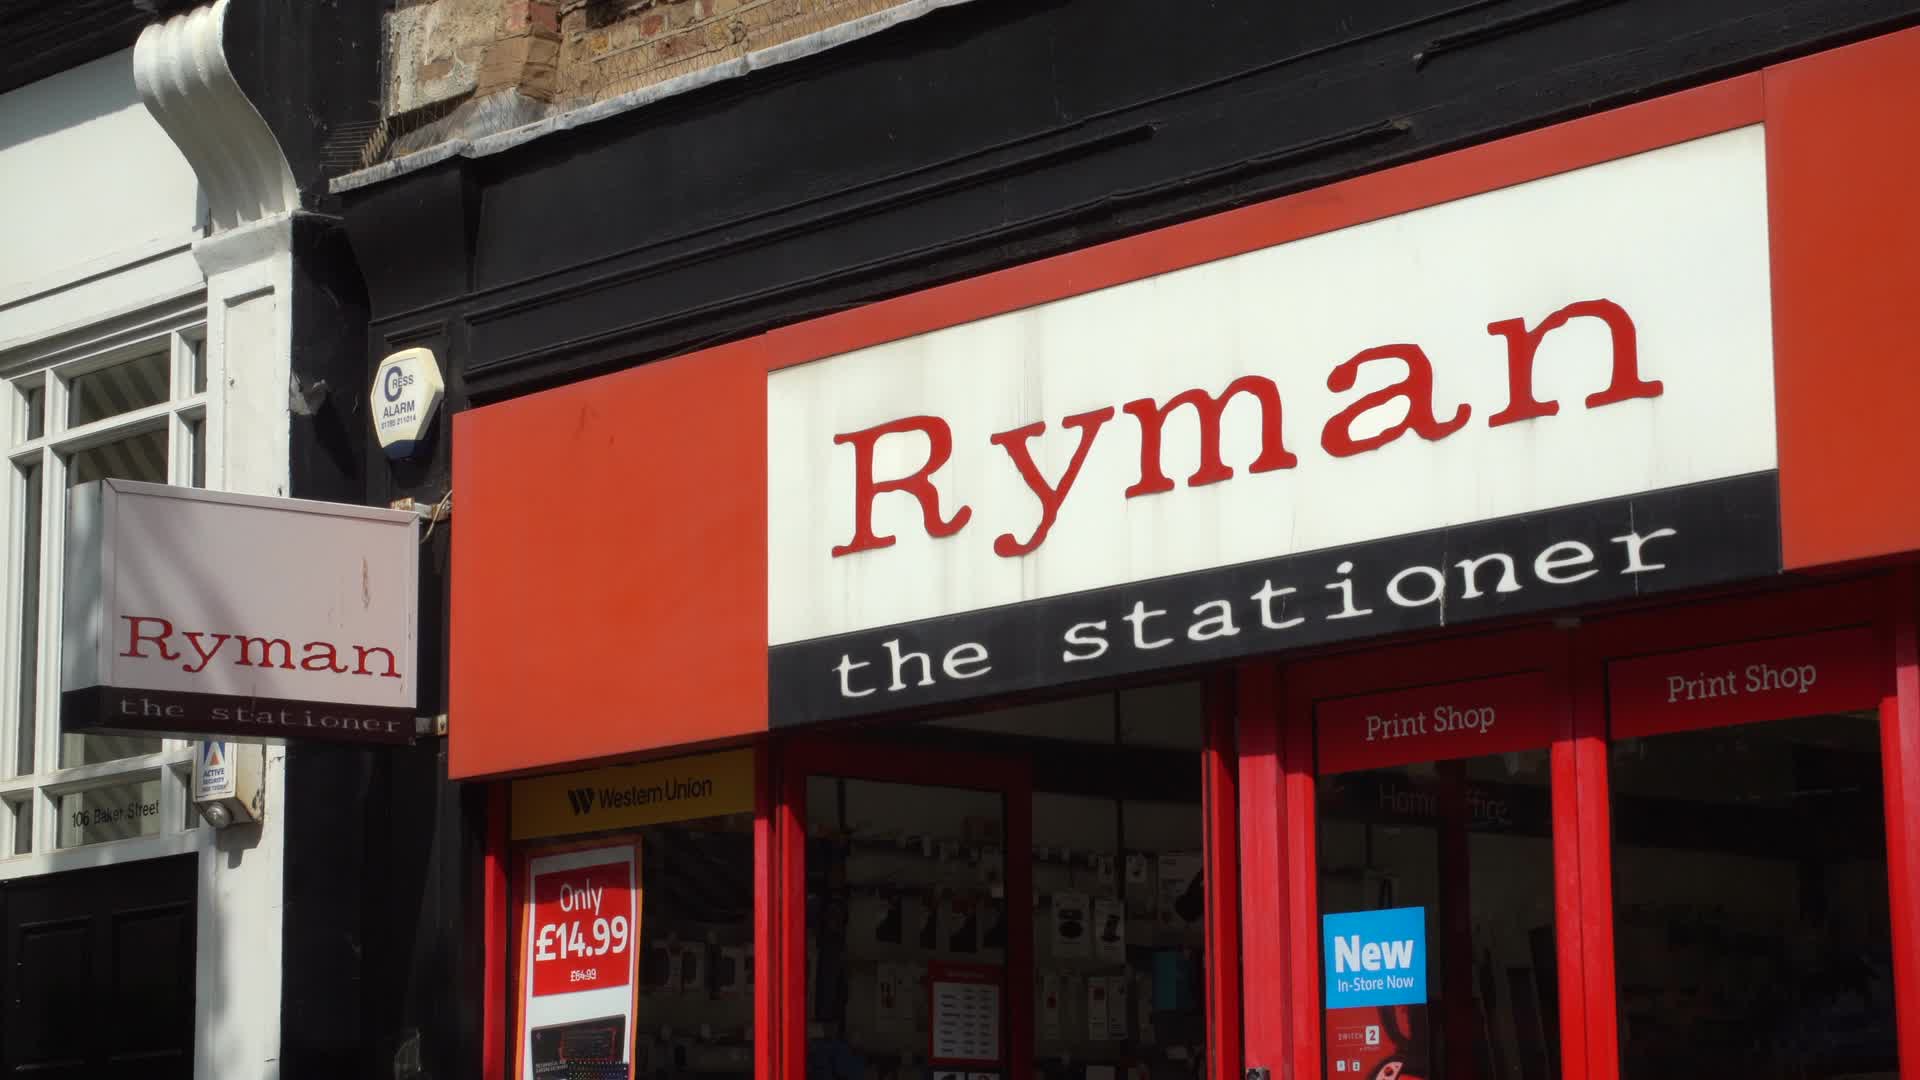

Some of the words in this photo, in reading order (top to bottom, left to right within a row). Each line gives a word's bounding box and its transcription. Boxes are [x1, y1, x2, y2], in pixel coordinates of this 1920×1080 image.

[383, 400, 415, 418] ALARM
[831, 298, 1663, 558] Ryman
[836, 638, 992, 700] the
[1062, 526, 1676, 663] stationer
[120, 615, 402, 679] Ryman
[1665, 668, 1738, 703] Print
[1745, 663, 1817, 693] Shop
[119, 698, 184, 718] the
[211, 704, 400, 734] stationer
[1365, 711, 1427, 742] Print
[1433, 704, 1496, 734] Shop
[203, 767, 225, 777] ACTIVE
[598, 785, 663, 809] Western
[664, 776, 713, 801] Union
[71, 810, 90, 828] 106
[94, 808, 123, 825] Baker
[128, 800, 160, 819] Street
[560, 878, 603, 916] Only
[535, 915, 628, 962] £14.99
[1334, 935, 1414, 973] New
[1338, 976, 1384, 993] In-Store
[1387, 976, 1414, 989] Now
